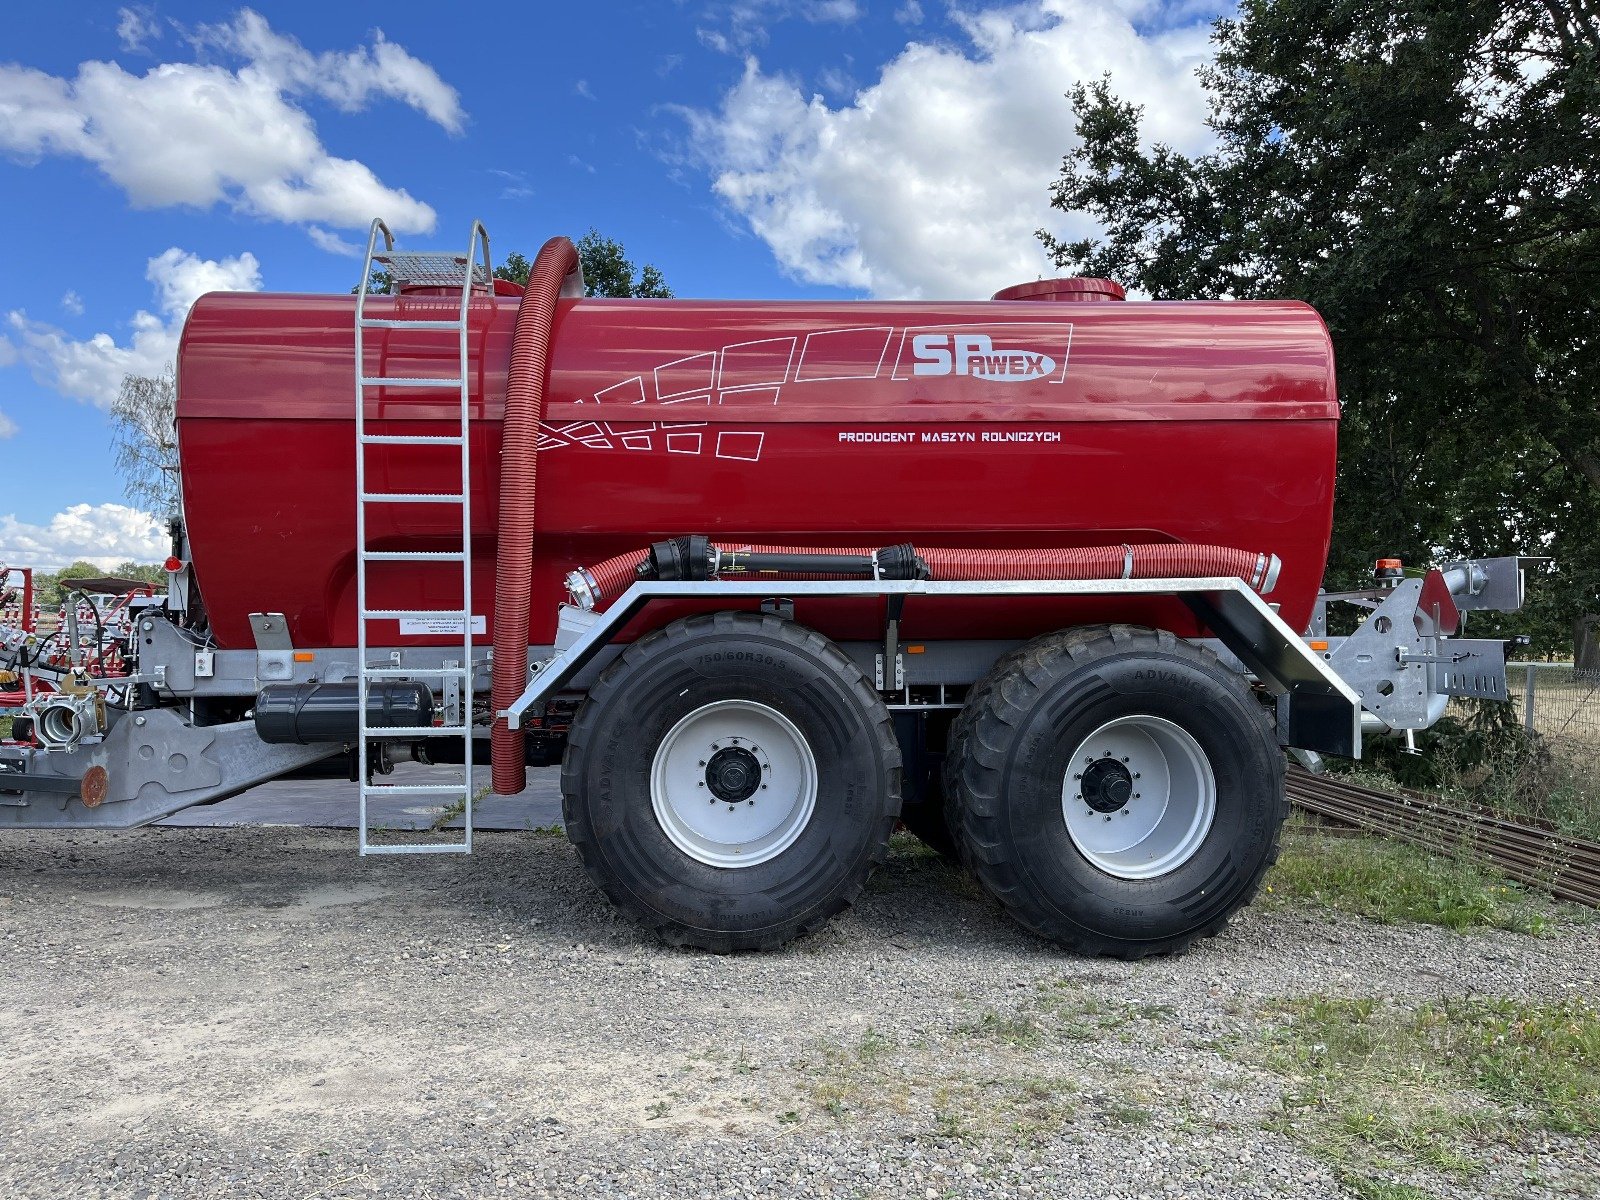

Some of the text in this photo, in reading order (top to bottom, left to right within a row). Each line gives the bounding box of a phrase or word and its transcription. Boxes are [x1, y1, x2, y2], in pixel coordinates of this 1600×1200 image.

[838, 431, 1061, 443] PRODUCENT MASZYN ROLNICZYCH
[695, 651, 787, 671] 750/60R30.5
